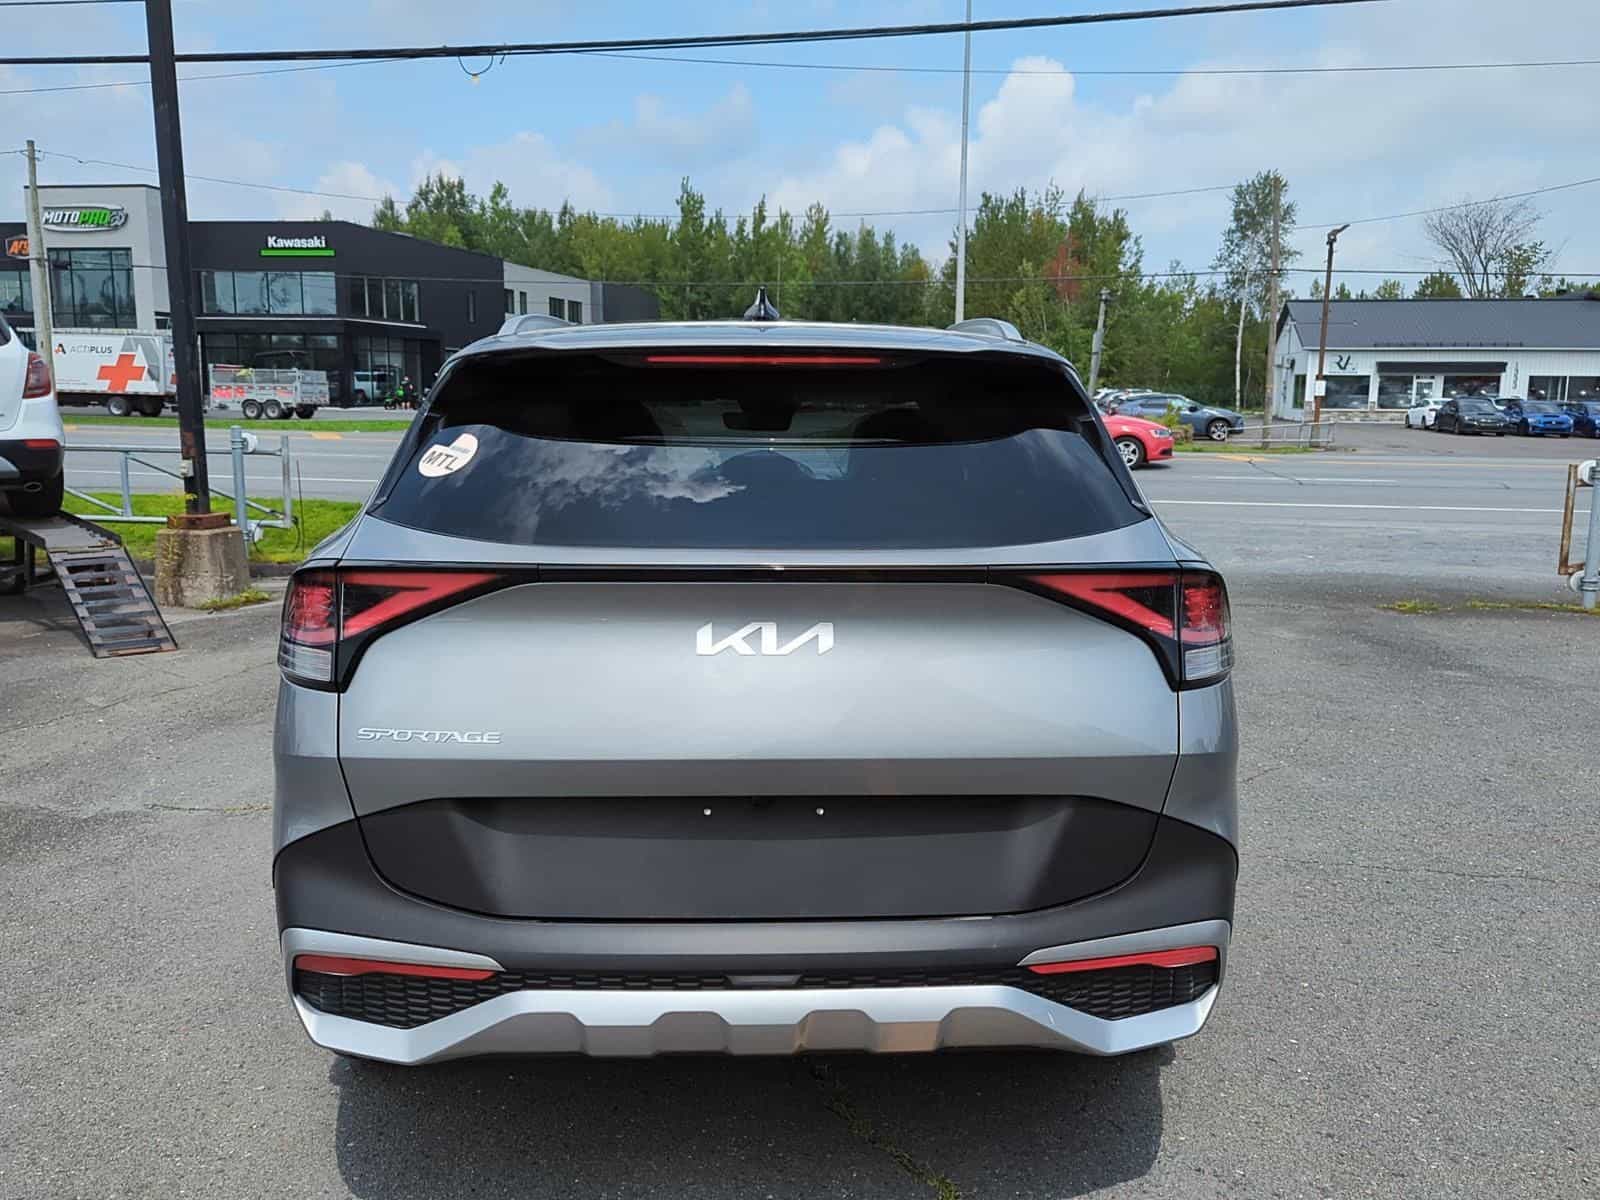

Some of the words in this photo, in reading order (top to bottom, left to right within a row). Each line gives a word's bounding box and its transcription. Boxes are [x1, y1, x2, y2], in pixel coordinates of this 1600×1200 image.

[42, 208, 111, 226] MOTOPRO
[267, 236, 326, 248] Kawasaki
[422, 450, 459, 471] MTL
[696, 622, 834, 656] KIA
[357, 727, 502, 744] SPORTAGE
